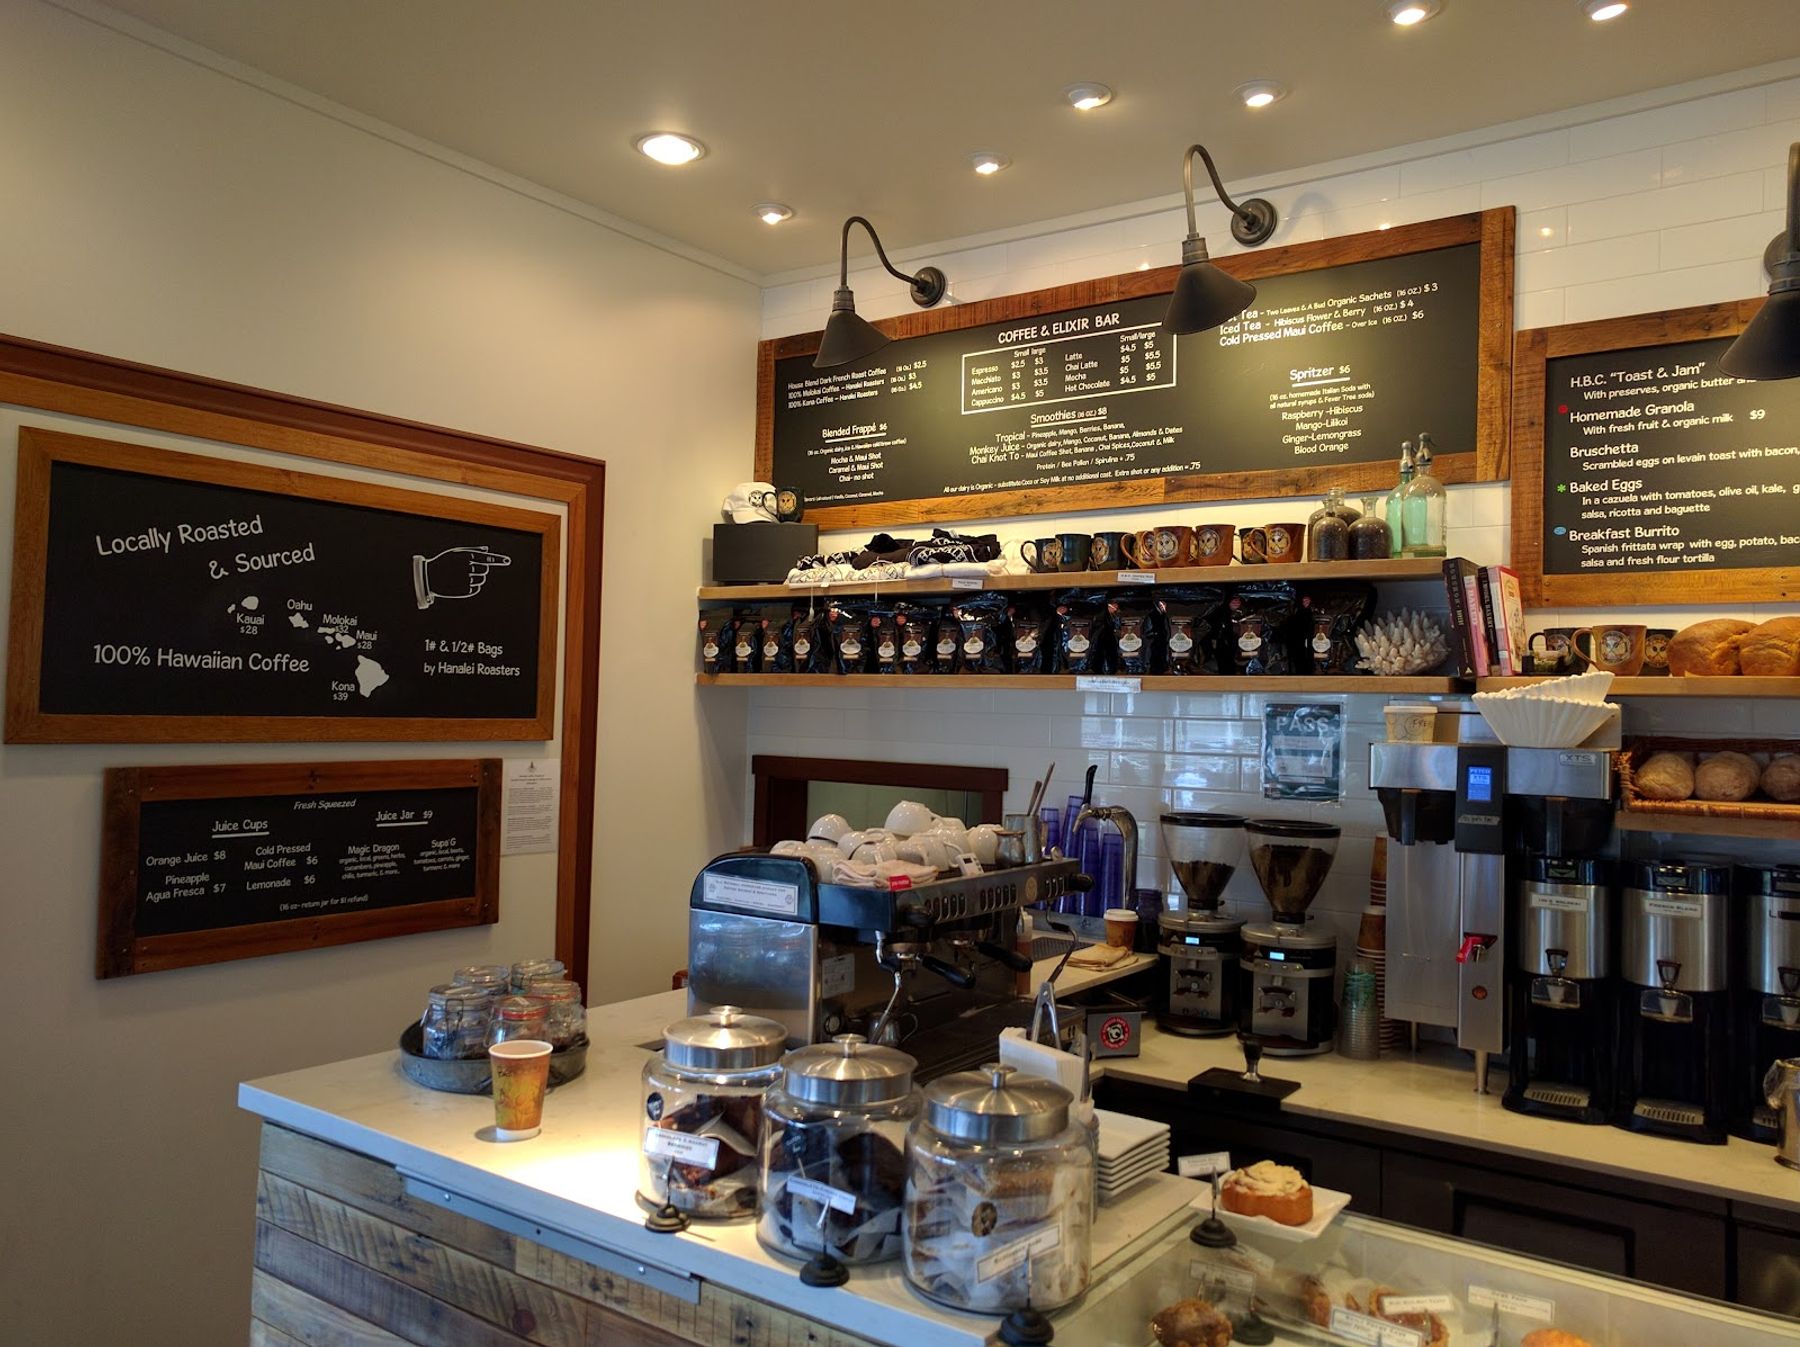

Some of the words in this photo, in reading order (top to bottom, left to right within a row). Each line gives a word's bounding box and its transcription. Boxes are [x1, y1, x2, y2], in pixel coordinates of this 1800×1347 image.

[998, 326, 1038, 344] COFFEE
[1040, 325, 1050, 337] &
[1053, 318, 1089, 335] ELIXIR
[1095, 313, 1120, 328] BAR
[1219, 332, 1240, 347] Cold
[1243, 328, 1282, 343] Pressed
[1283, 325, 1306, 338] Maui
[1308, 321, 1344, 334] Coffee
[1014, 348, 1029, 358] Small
[1031, 348, 1046, 356] large
[1065, 353, 1083, 361] Latte
[1120, 343, 1136, 353] $4.5
[1144, 340, 1154, 349] $5
[971, 366, 998, 376] Espresso
[1011, 359, 1025, 369] $2.5
[1034, 357, 1044, 365] $3
[1065, 362, 1079, 372] Chai
[1080, 361, 1098, 370] Latte
[1121, 355, 1131, 363] $5
[1145, 350, 1161, 360] $5.5
[971, 375, 1001, 386] Macchiato
[1012, 371, 1021, 379] $3
[1034, 367, 1049, 376] $3.5
[1065, 373, 1086, 382] Mocha
[1119, 365, 1129, 374] $5
[1146, 361, 1161, 371] $5.5
[1289, 367, 1334, 382] Spritzer
[1339, 365, 1350, 374] $6
[1571, 374, 1607, 388] H.B.C.
[1656, 367, 1669, 378] &
[971, 386, 1003, 396] Americano
[1012, 382, 1020, 390] $3
[1033, 377, 1048, 387] $3.5
[1065, 384, 1077, 392] Hot
[1078, 380, 1110, 390] Chocolate
[1120, 375, 1136, 384] $4.5
[1146, 372, 1156, 381] $5
[1584, 390, 1607, 400] With
[1608, 386, 1660, 400] preserves,
[1662, 380, 1699, 393] organic
[1701, 377, 1735, 388] butter
[971, 396, 1004, 407] Cappuccino
[1011, 392, 1026, 401] $4.5
[1035, 389, 1044, 398] $5
[1030, 409, 1077, 424] Smoothies
[1282, 410, 1324, 421] Raspberry
[1570, 406, 1642, 423] Homemade
[1645, 400, 1695, 416] Granola
[1583, 425, 1606, 435] With
[1608, 422, 1635, 433] fresh
[1637, 420, 1659, 430] fruit
[1661, 419, 1671, 428] &
[1673, 415, 1710, 428] organic
[1712, 413, 1734, 424] milk
[1750, 409, 1766, 420] $9
[822, 426, 851, 438] Blended
[852, 423, 877, 437] Frappé
[879, 423, 888, 431] $6
[1282, 429, 1362, 445] Ginger-Lemongrass
[1294, 444, 1317, 454] Blood
[1319, 443, 1349, 452] Orange
[1570, 443, 1639, 458] Bruschetta
[1583, 458, 1634, 471] Scrambled
[1635, 458, 1660, 468] eggs
[1677, 453, 1706, 463] levain
[1708, 450, 1736, 461] toast
[1738, 448, 1763, 458] with
[1570, 480, 1608, 493] Baked
[1612, 479, 1643, 493] Eggs
[1582, 497, 1592, 505] In
[1602, 493, 1638, 504] cazuela
[1640, 491, 1662, 501] with
[1665, 489, 1716, 500] tomatoes,
[1718, 486, 1743, 496] olive
[1761, 483, 1786, 494] kale,
[1581, 509, 1607, 519] salsa,
[1609, 508, 1641, 517] ricotta
[1643, 505, 1662, 515] and
[1664, 503, 1710, 516] baguette
[96, 527, 171, 555] Locally
[177, 514, 263, 544] Roasted
[1569, 528, 1631, 541] Breakfast
[1634, 525, 1680, 538] Burrito
[1582, 543, 1619, 555] Spanish
[1621, 542, 1657, 552] frittata
[1659, 542, 1685, 551] wrap
[1689, 539, 1712, 548] with
[1714, 539, 1737, 550] egg,
[1739, 536, 1778, 549] potato,
[1780, 535, 1800, 544] bac
[209, 560, 229, 579] &
[235, 542, 315, 572] Sourced
[1581, 558, 1604, 567] salsa
[1606, 556, 1625, 566] and
[1627, 555, 1654, 565] fresh
[1656, 555, 1680, 564] flour
[1682, 553, 1715, 563] tortilla
[287, 599, 313, 611] Oahu
[237, 613, 265, 625] Kauai
[323, 614, 357, 626] Molokai
[240, 625, 258, 635] $28
[356, 630, 378, 641] Maui
[357, 641, 372, 650] $28
[425, 639, 436, 652] 1#
[439, 640, 449, 652] &
[452, 640, 475, 653] 1/2#
[478, 642, 503, 658] Bags
[94, 644, 151, 666] 100%
[157, 648, 242, 670] Hawaiian
[249, 653, 310, 672] Coffee
[424, 662, 436, 676] by
[438, 662, 475, 675] Hanalei
[477, 663, 520, 676] Roasters
[331, 681, 355, 692] Kona
[333, 692, 349, 701] $39
[293, 801, 317, 810] Fresh
[318, 799, 357, 810] Squeezed
[375, 811, 397, 821] Juice
[400, 810, 415, 820] Jar
[423, 810, 433, 819] $9
[212, 820, 239, 832] Juice
[243, 819, 268, 832] Cups
[255, 845, 275, 856] Cold
[276, 842, 311, 854] Pressed
[348, 845, 372, 858] Magic
[373, 844, 400, 854] Dragon
[146, 856, 181, 867] Orange
[184, 852, 208, 863] Juice
[214, 850, 226, 860] $8
[244, 860, 265, 871] Maui
[266, 857, 296, 868] Coffee
[306, 856, 318, 865] $6
[165, 872, 210, 886] Pineapple
[246, 877, 291, 891] Lemonade
[304, 874, 316, 884] $6
[146, 891, 171, 903] Agua
[173, 887, 205, 898] Fresca
[213, 883, 226, 893] $7
